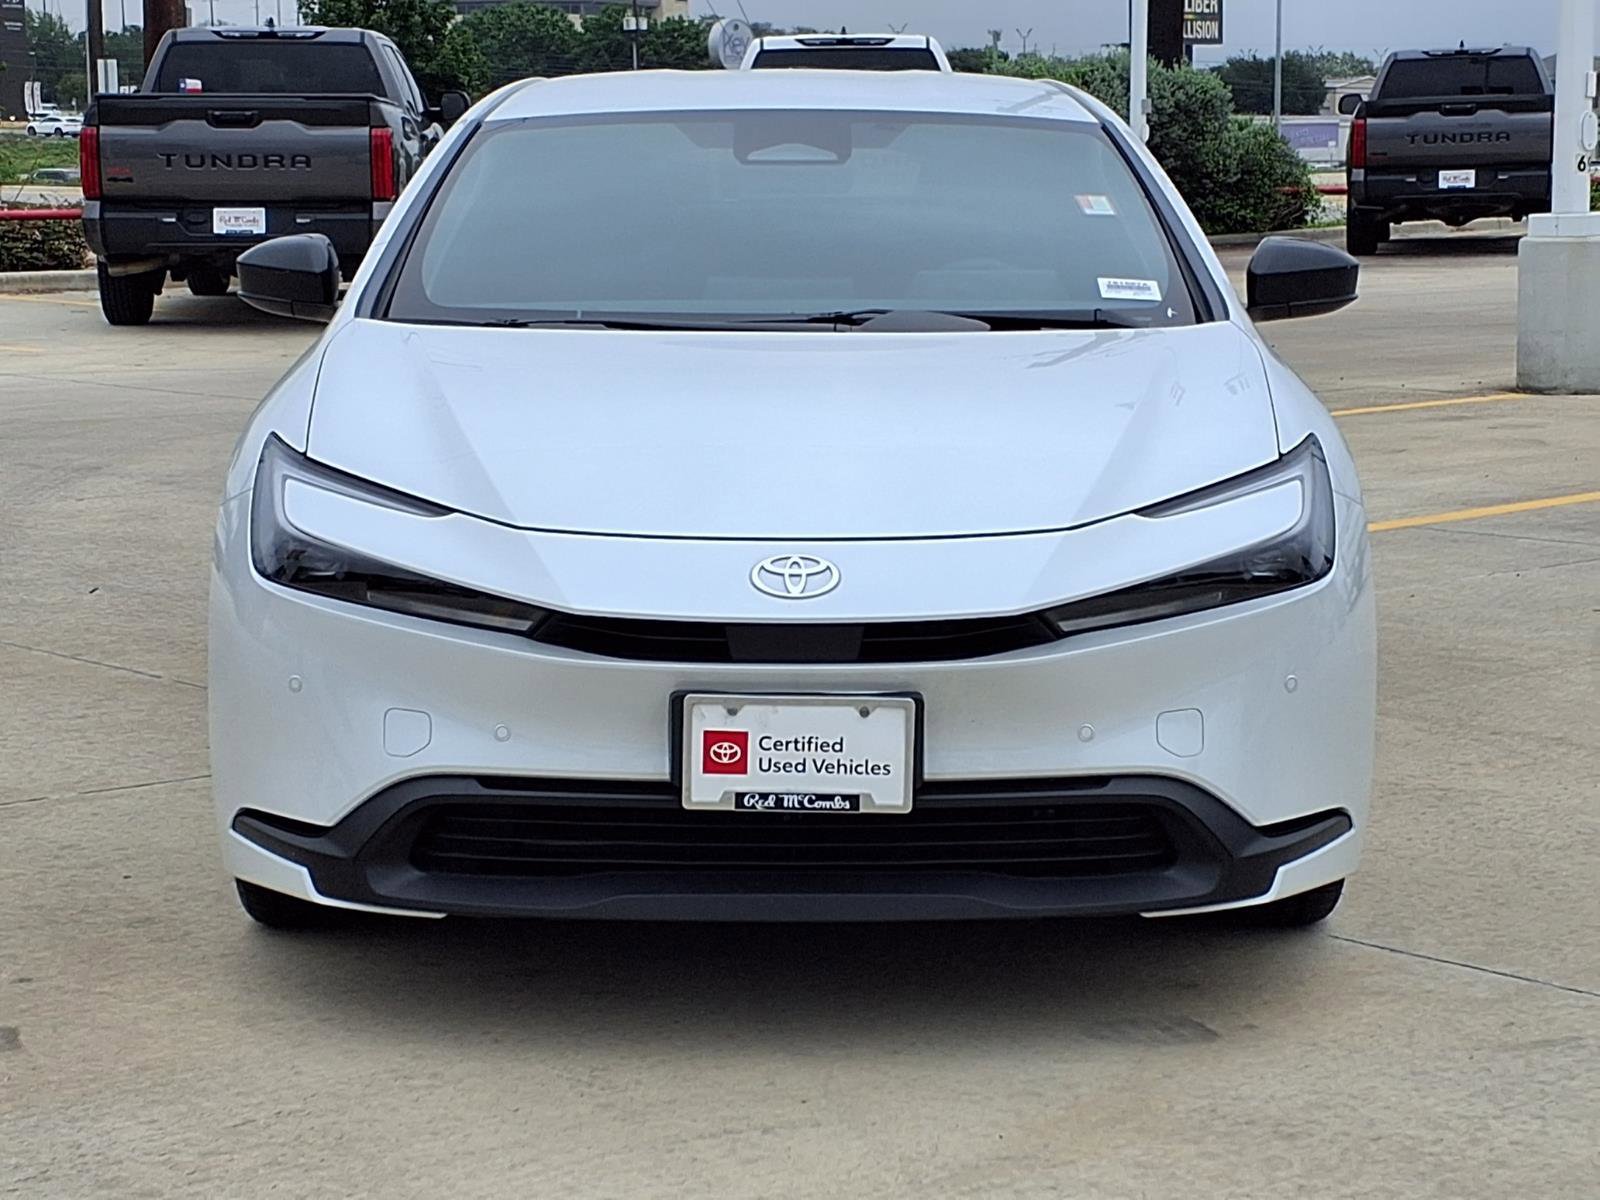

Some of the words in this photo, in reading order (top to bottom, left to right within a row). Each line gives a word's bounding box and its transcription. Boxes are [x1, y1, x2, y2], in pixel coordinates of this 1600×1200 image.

[1184, 0, 1218, 13] LIBER
[1183, 20, 1219, 39] LLISION
[1406, 131, 1511, 146] TUNDRA
[158, 153, 312, 170] TUNDRA
[758, 735, 844, 753] Certified
[758, 757, 807, 774] Used
[812, 758, 892, 776] Vehicles
[743, 792, 776, 810] Red
[777, 794, 850, 810] McCombs
